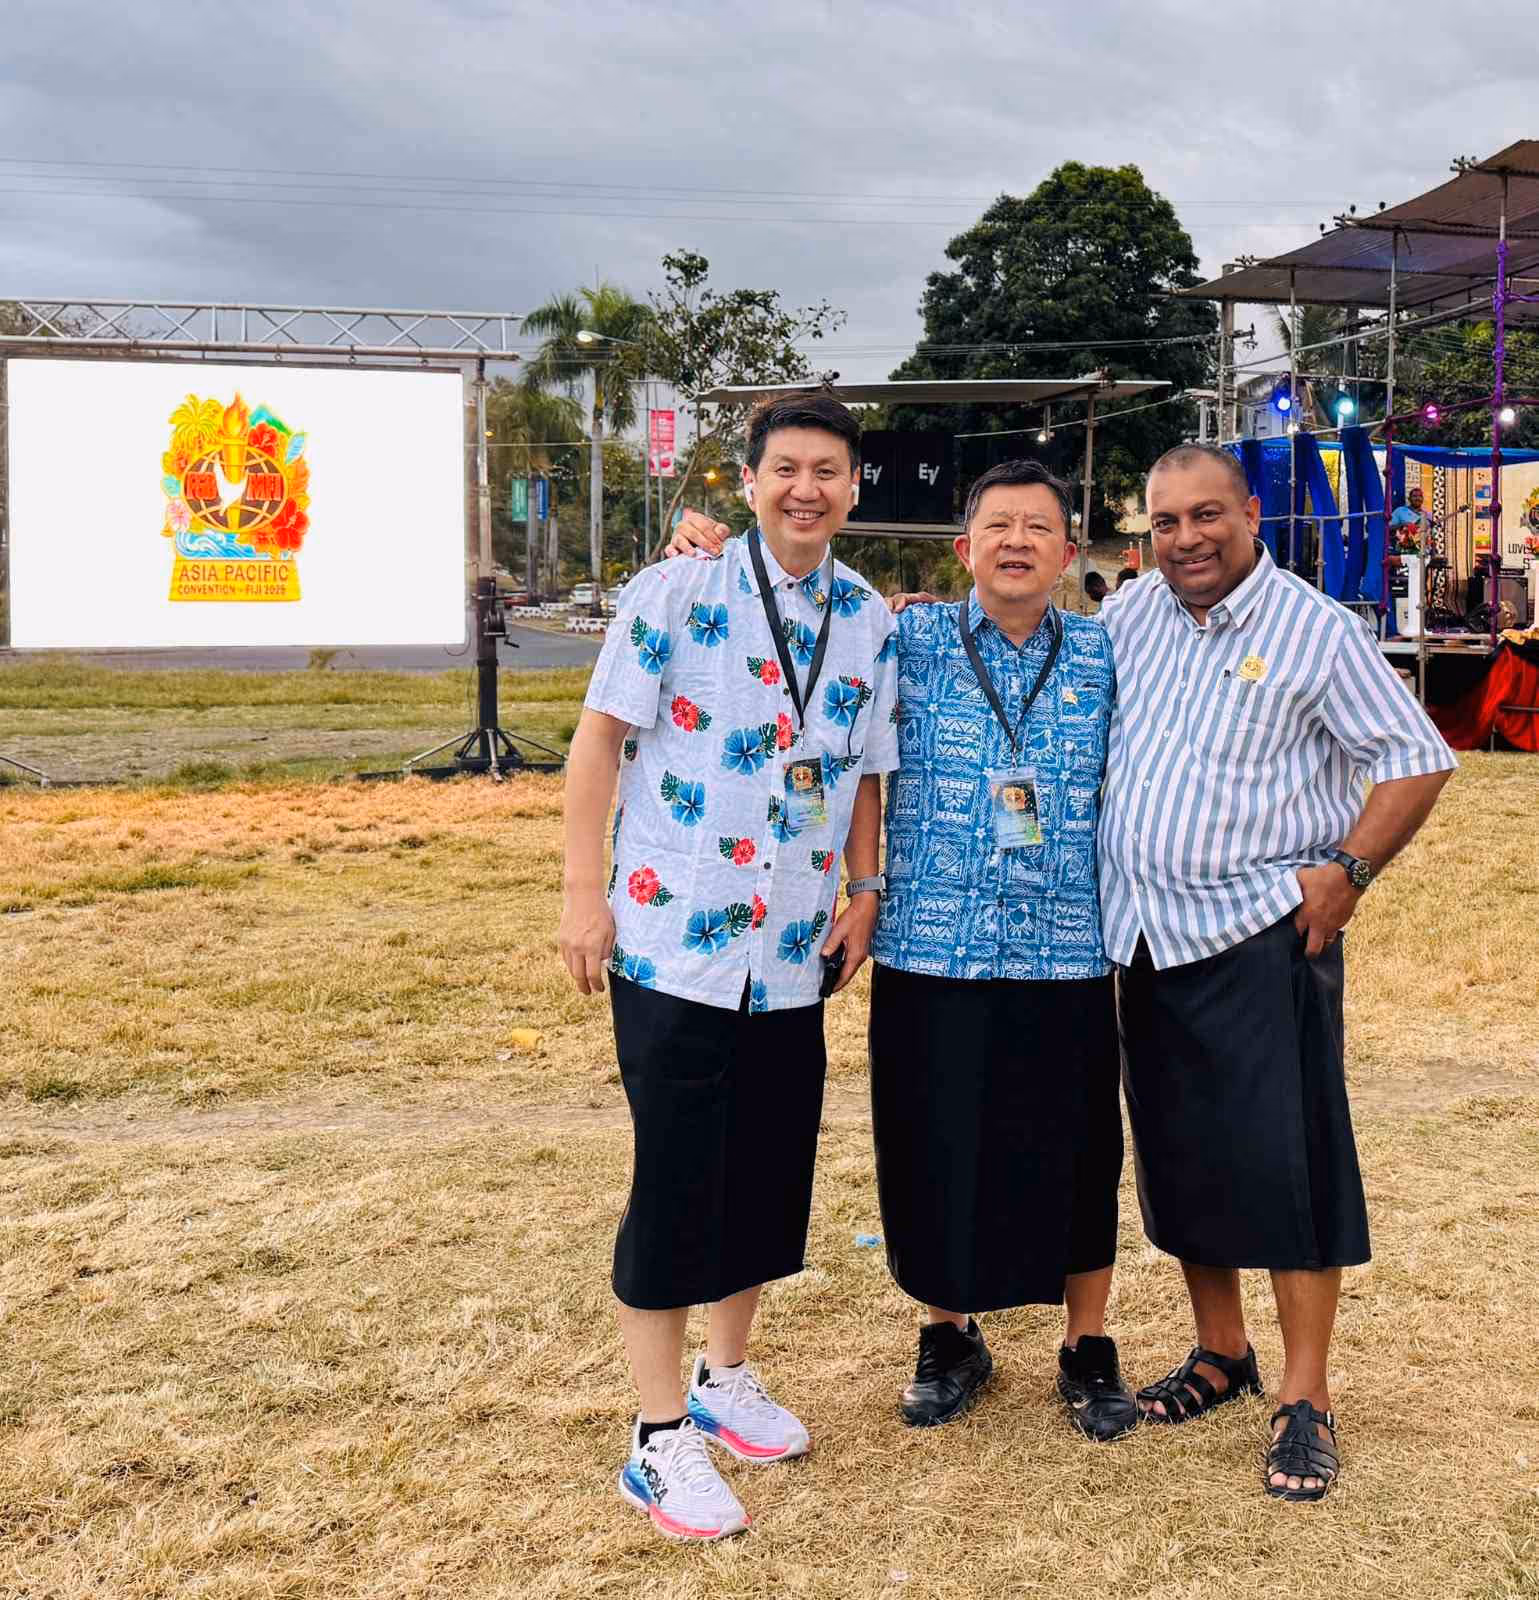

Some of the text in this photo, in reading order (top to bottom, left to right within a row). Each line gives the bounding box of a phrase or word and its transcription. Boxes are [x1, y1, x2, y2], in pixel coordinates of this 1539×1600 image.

[180, 564, 288, 581] ASIA PACIFIC
[177, 584, 236, 595] CONVENTION
[245, 584, 262, 595] FIJI
[639, 1458, 668, 1504] HOKA
